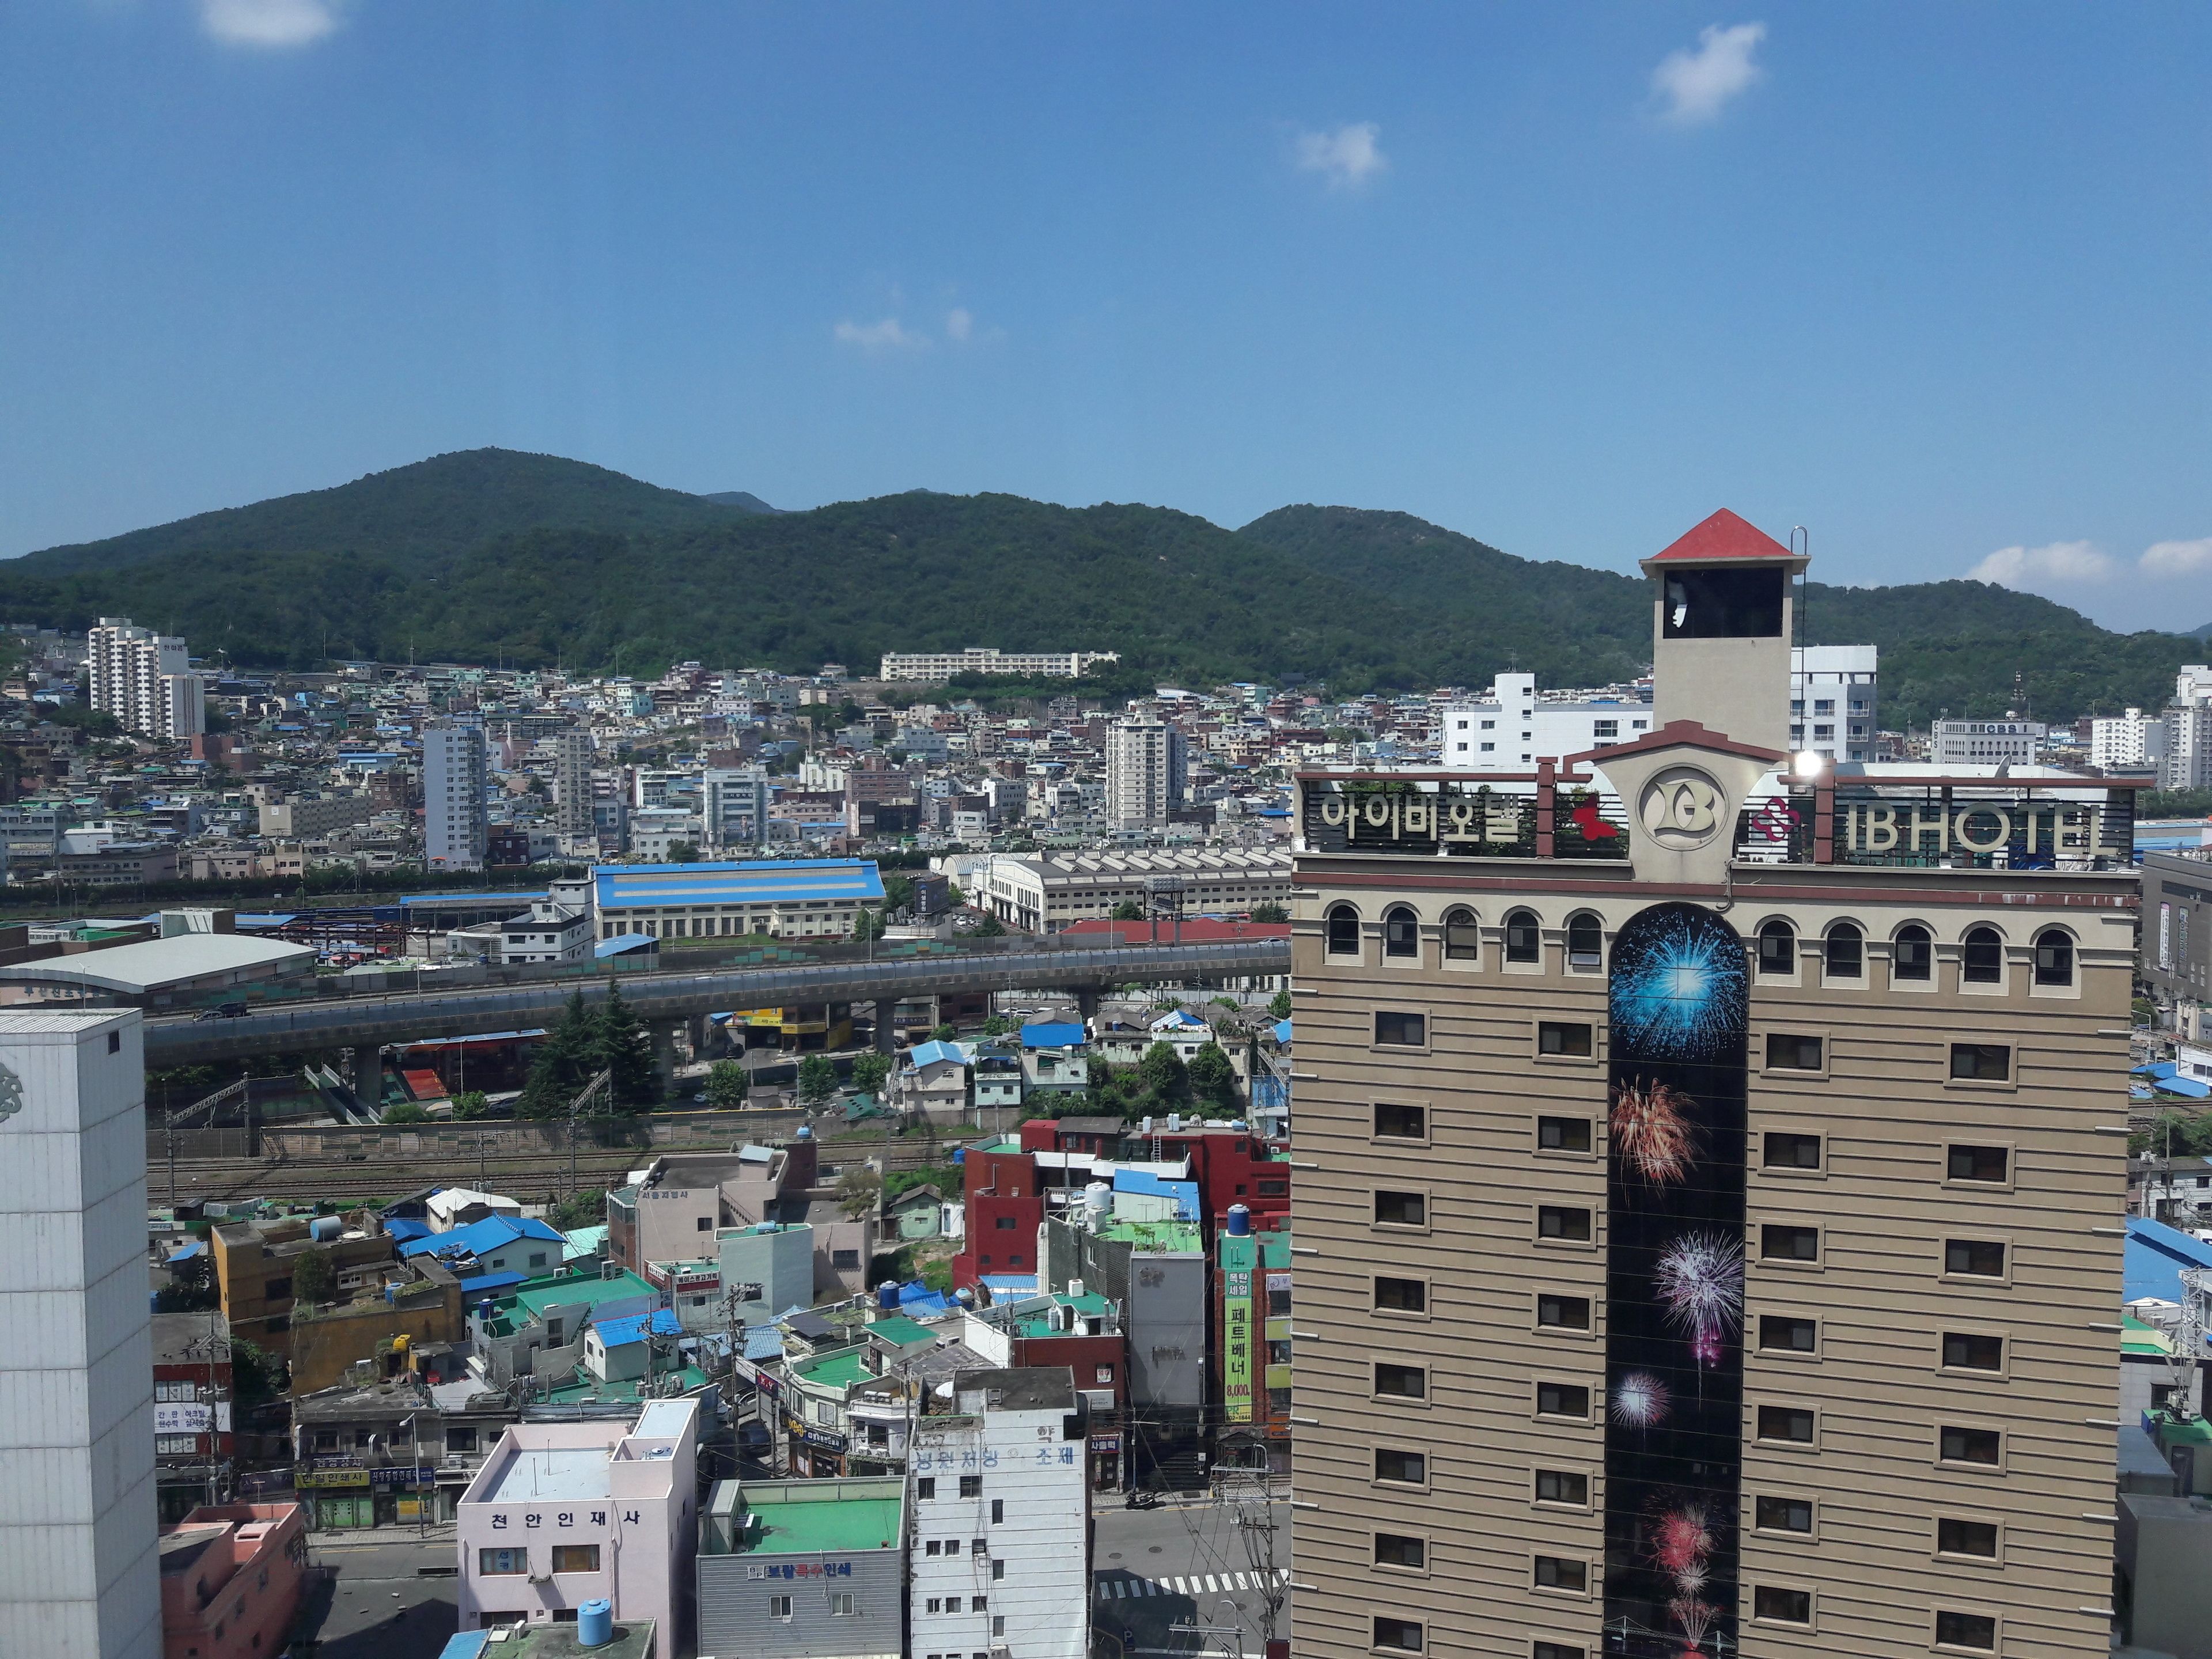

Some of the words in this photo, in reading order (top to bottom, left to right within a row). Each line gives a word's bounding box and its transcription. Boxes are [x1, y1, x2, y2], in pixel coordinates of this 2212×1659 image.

[1987, 724, 2017, 734] CBS
[1322, 793, 1518, 843] 아이비호텔
[1228, 1272, 1249, 1284] 폭탄
[1228, 1285, 1249, 1296] 세일
[1231, 1308, 1245, 1376] 페트베너
[185, 1410, 205, 1418] 아크릴
[1037, 1427, 1055, 1443] 약
[917, 1450, 999, 1471] 병원처방
[1036, 1446, 1074, 1465] 조제
[1124, 1631, 1132, 1643] P
